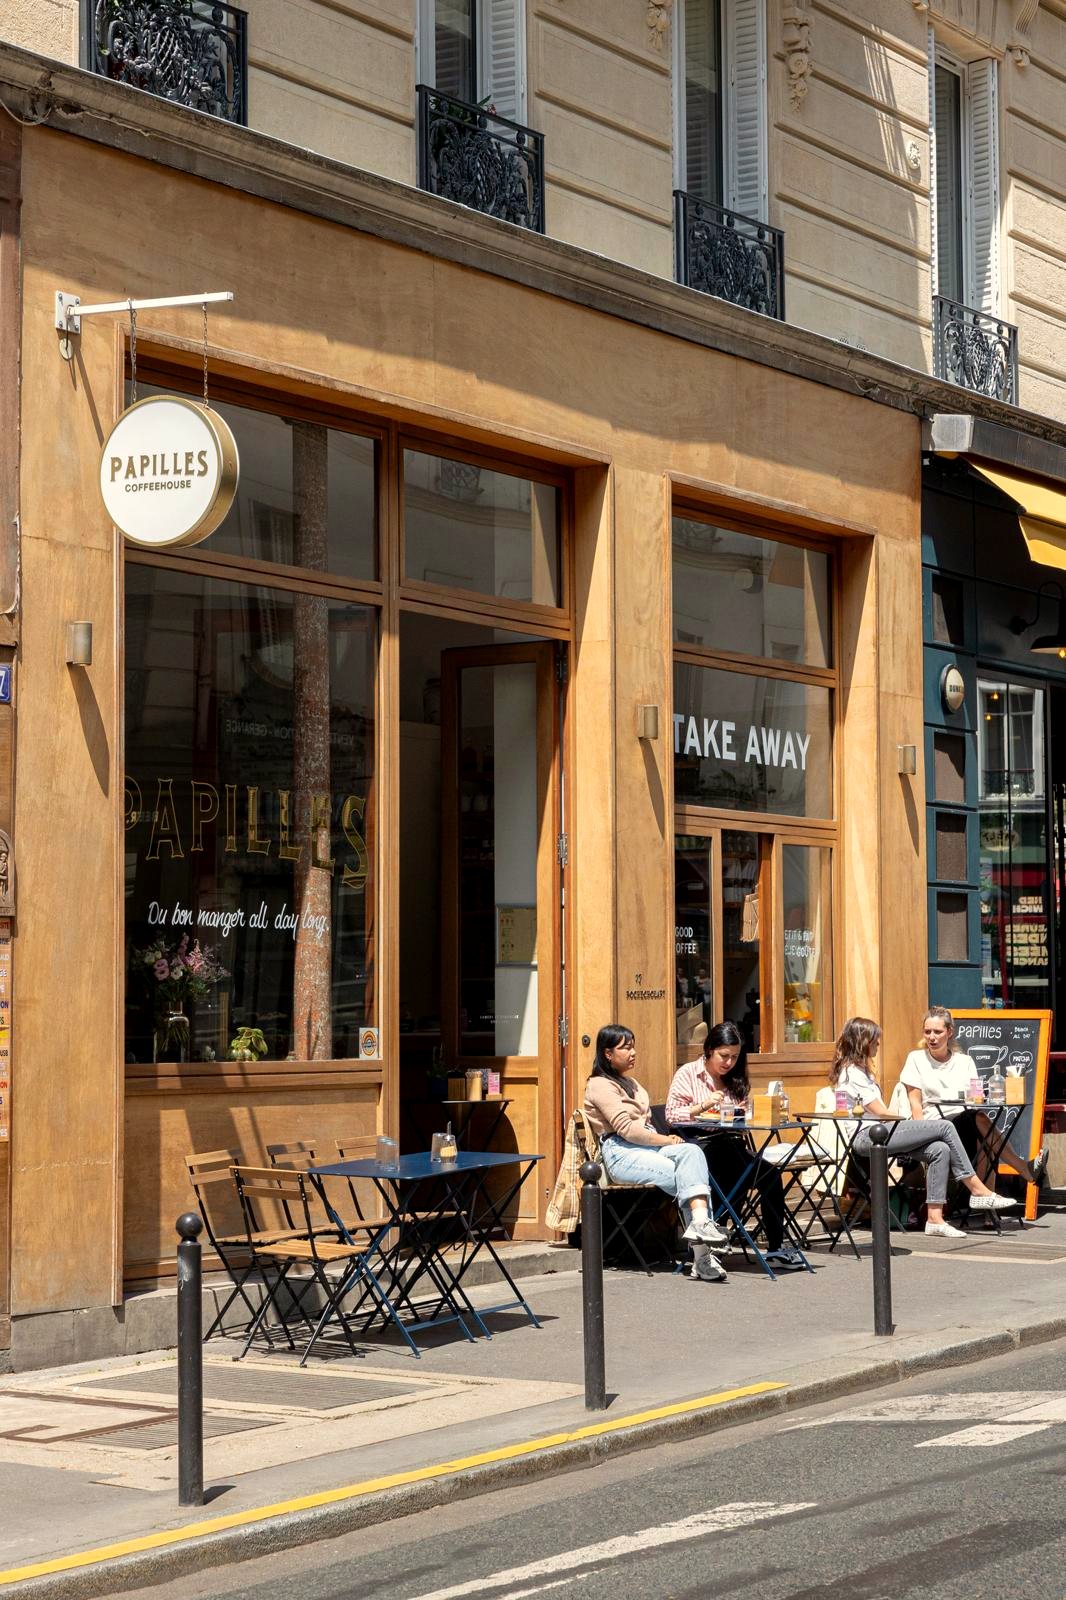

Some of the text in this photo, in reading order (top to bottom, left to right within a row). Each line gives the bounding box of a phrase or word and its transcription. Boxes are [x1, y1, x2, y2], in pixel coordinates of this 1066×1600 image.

[110, 450, 208, 482] PAPILLES
[125, 480, 191, 492] COFFEEHOUSE
[672, 713, 811, 770] TAKE AWAY
[148, 901, 167, 925] Du
[171, 901, 194, 926] bon
[197, 908, 246, 937] manger
[249, 901, 268, 929] all
[274, 903, 300, 940] day
[675, 926, 693, 937] GOOD
[676, 943, 696, 954] OFFEE
